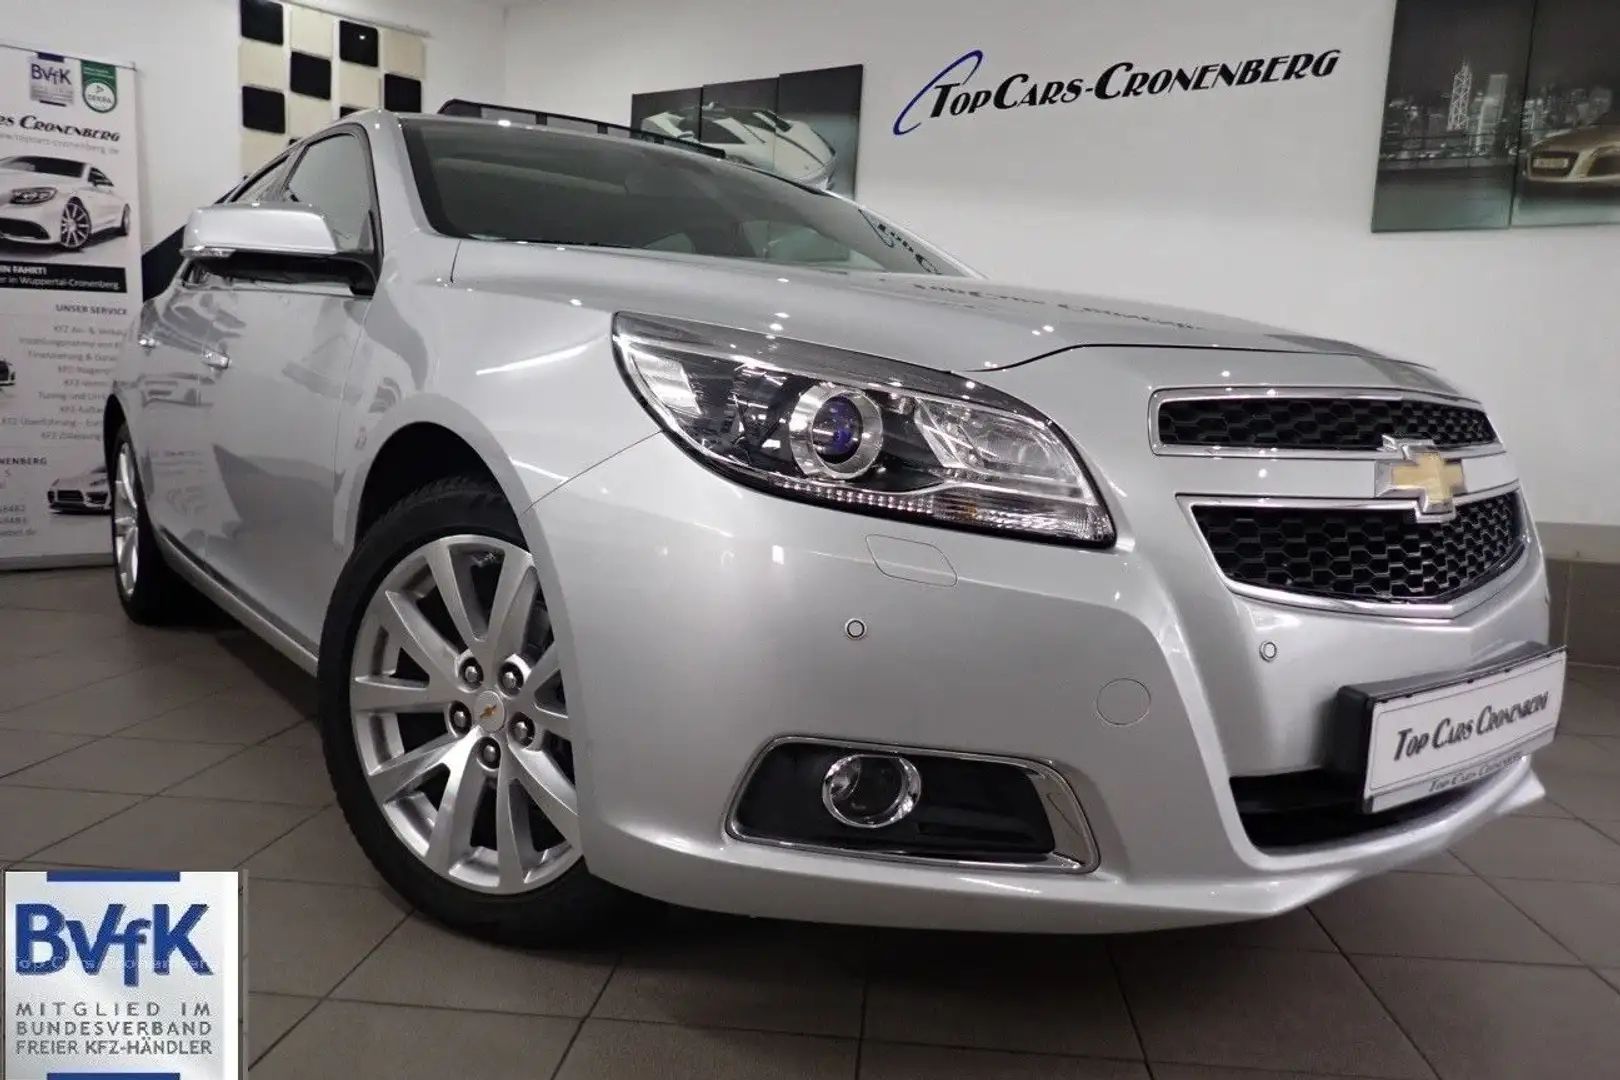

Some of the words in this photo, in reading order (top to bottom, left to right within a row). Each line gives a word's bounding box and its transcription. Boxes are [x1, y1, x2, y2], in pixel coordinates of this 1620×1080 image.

[56, 304, 89, 313] UNSER
[90, 306, 127, 315] SERVICE
[1394, 727, 1430, 761] TOP
[1432, 717, 1474, 750] CARS
